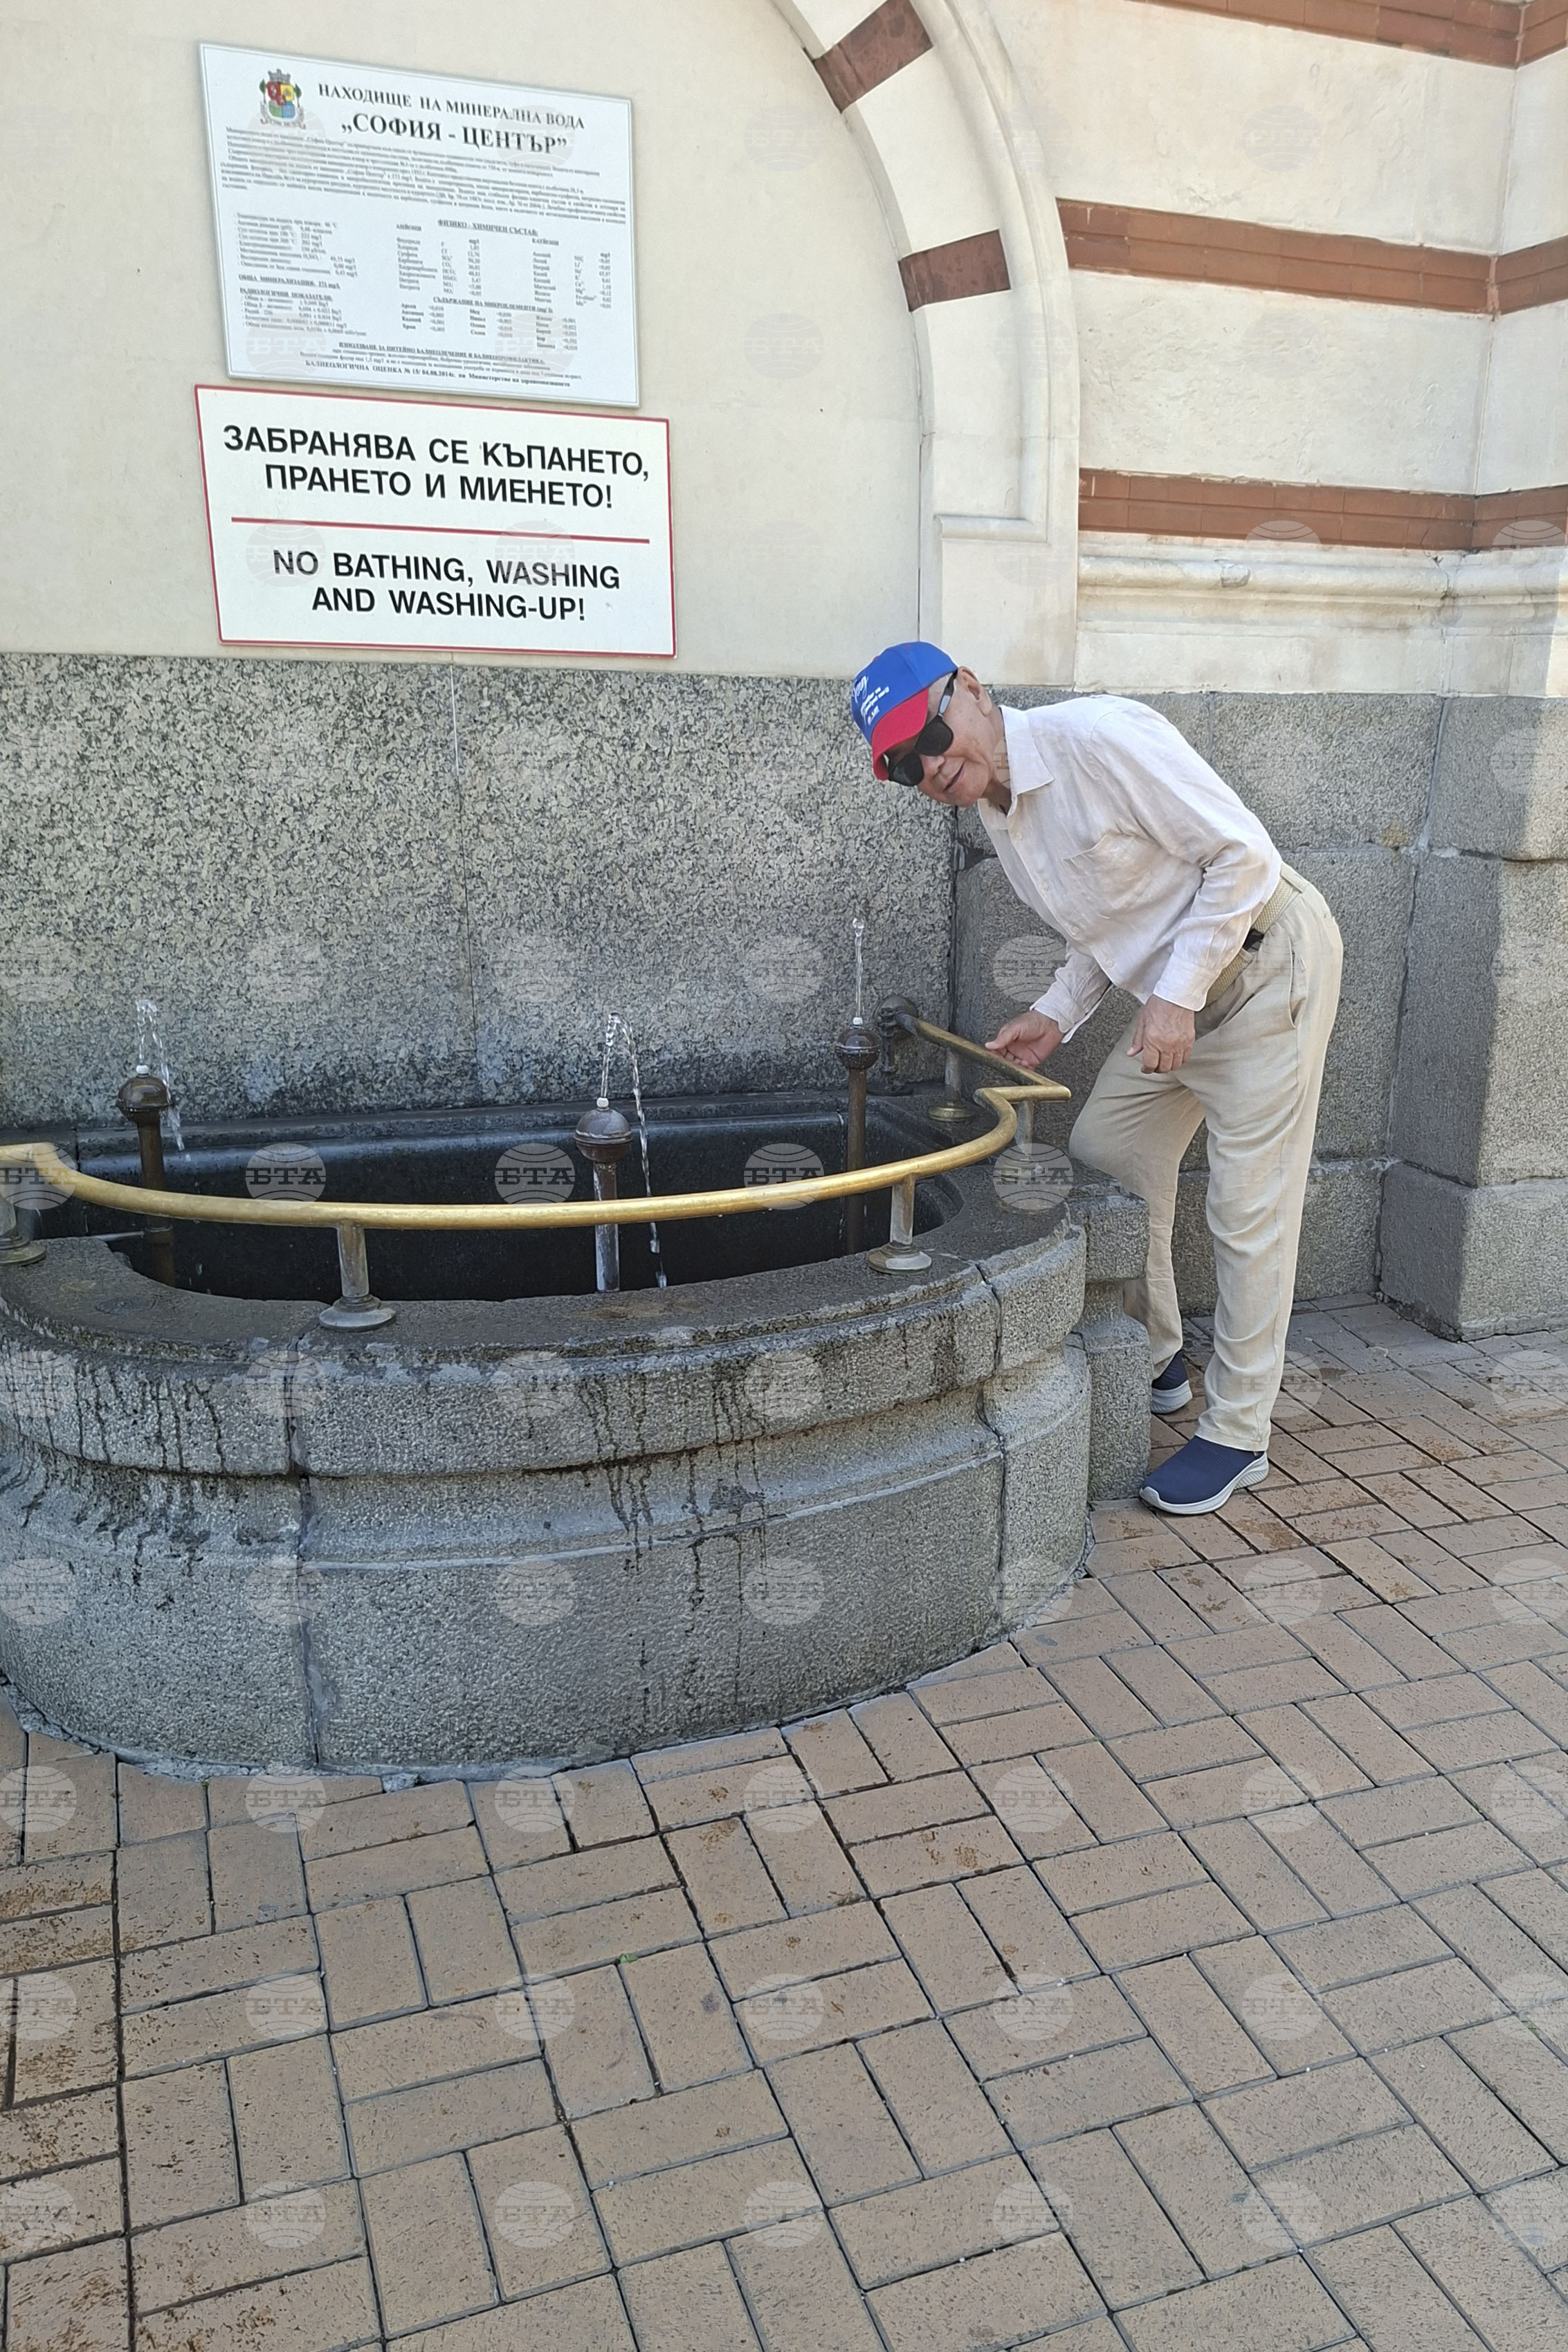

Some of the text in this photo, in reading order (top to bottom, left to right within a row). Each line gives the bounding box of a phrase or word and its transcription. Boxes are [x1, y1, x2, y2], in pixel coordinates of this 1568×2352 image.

[318, 83, 584, 131] НАХОДИЩЕ НА МИНЕРАЛНА ВОДА
[224, 424, 650, 482] ЗАБРАНЯВА СЕ КЪПАНЕТО,
[265, 463, 612, 509] ПРАНЕТО И МИЕНЕТО!
[273, 549, 620, 590] NO BATHING, WASHING
[312, 587, 585, 621] AND WASHING-UP!
